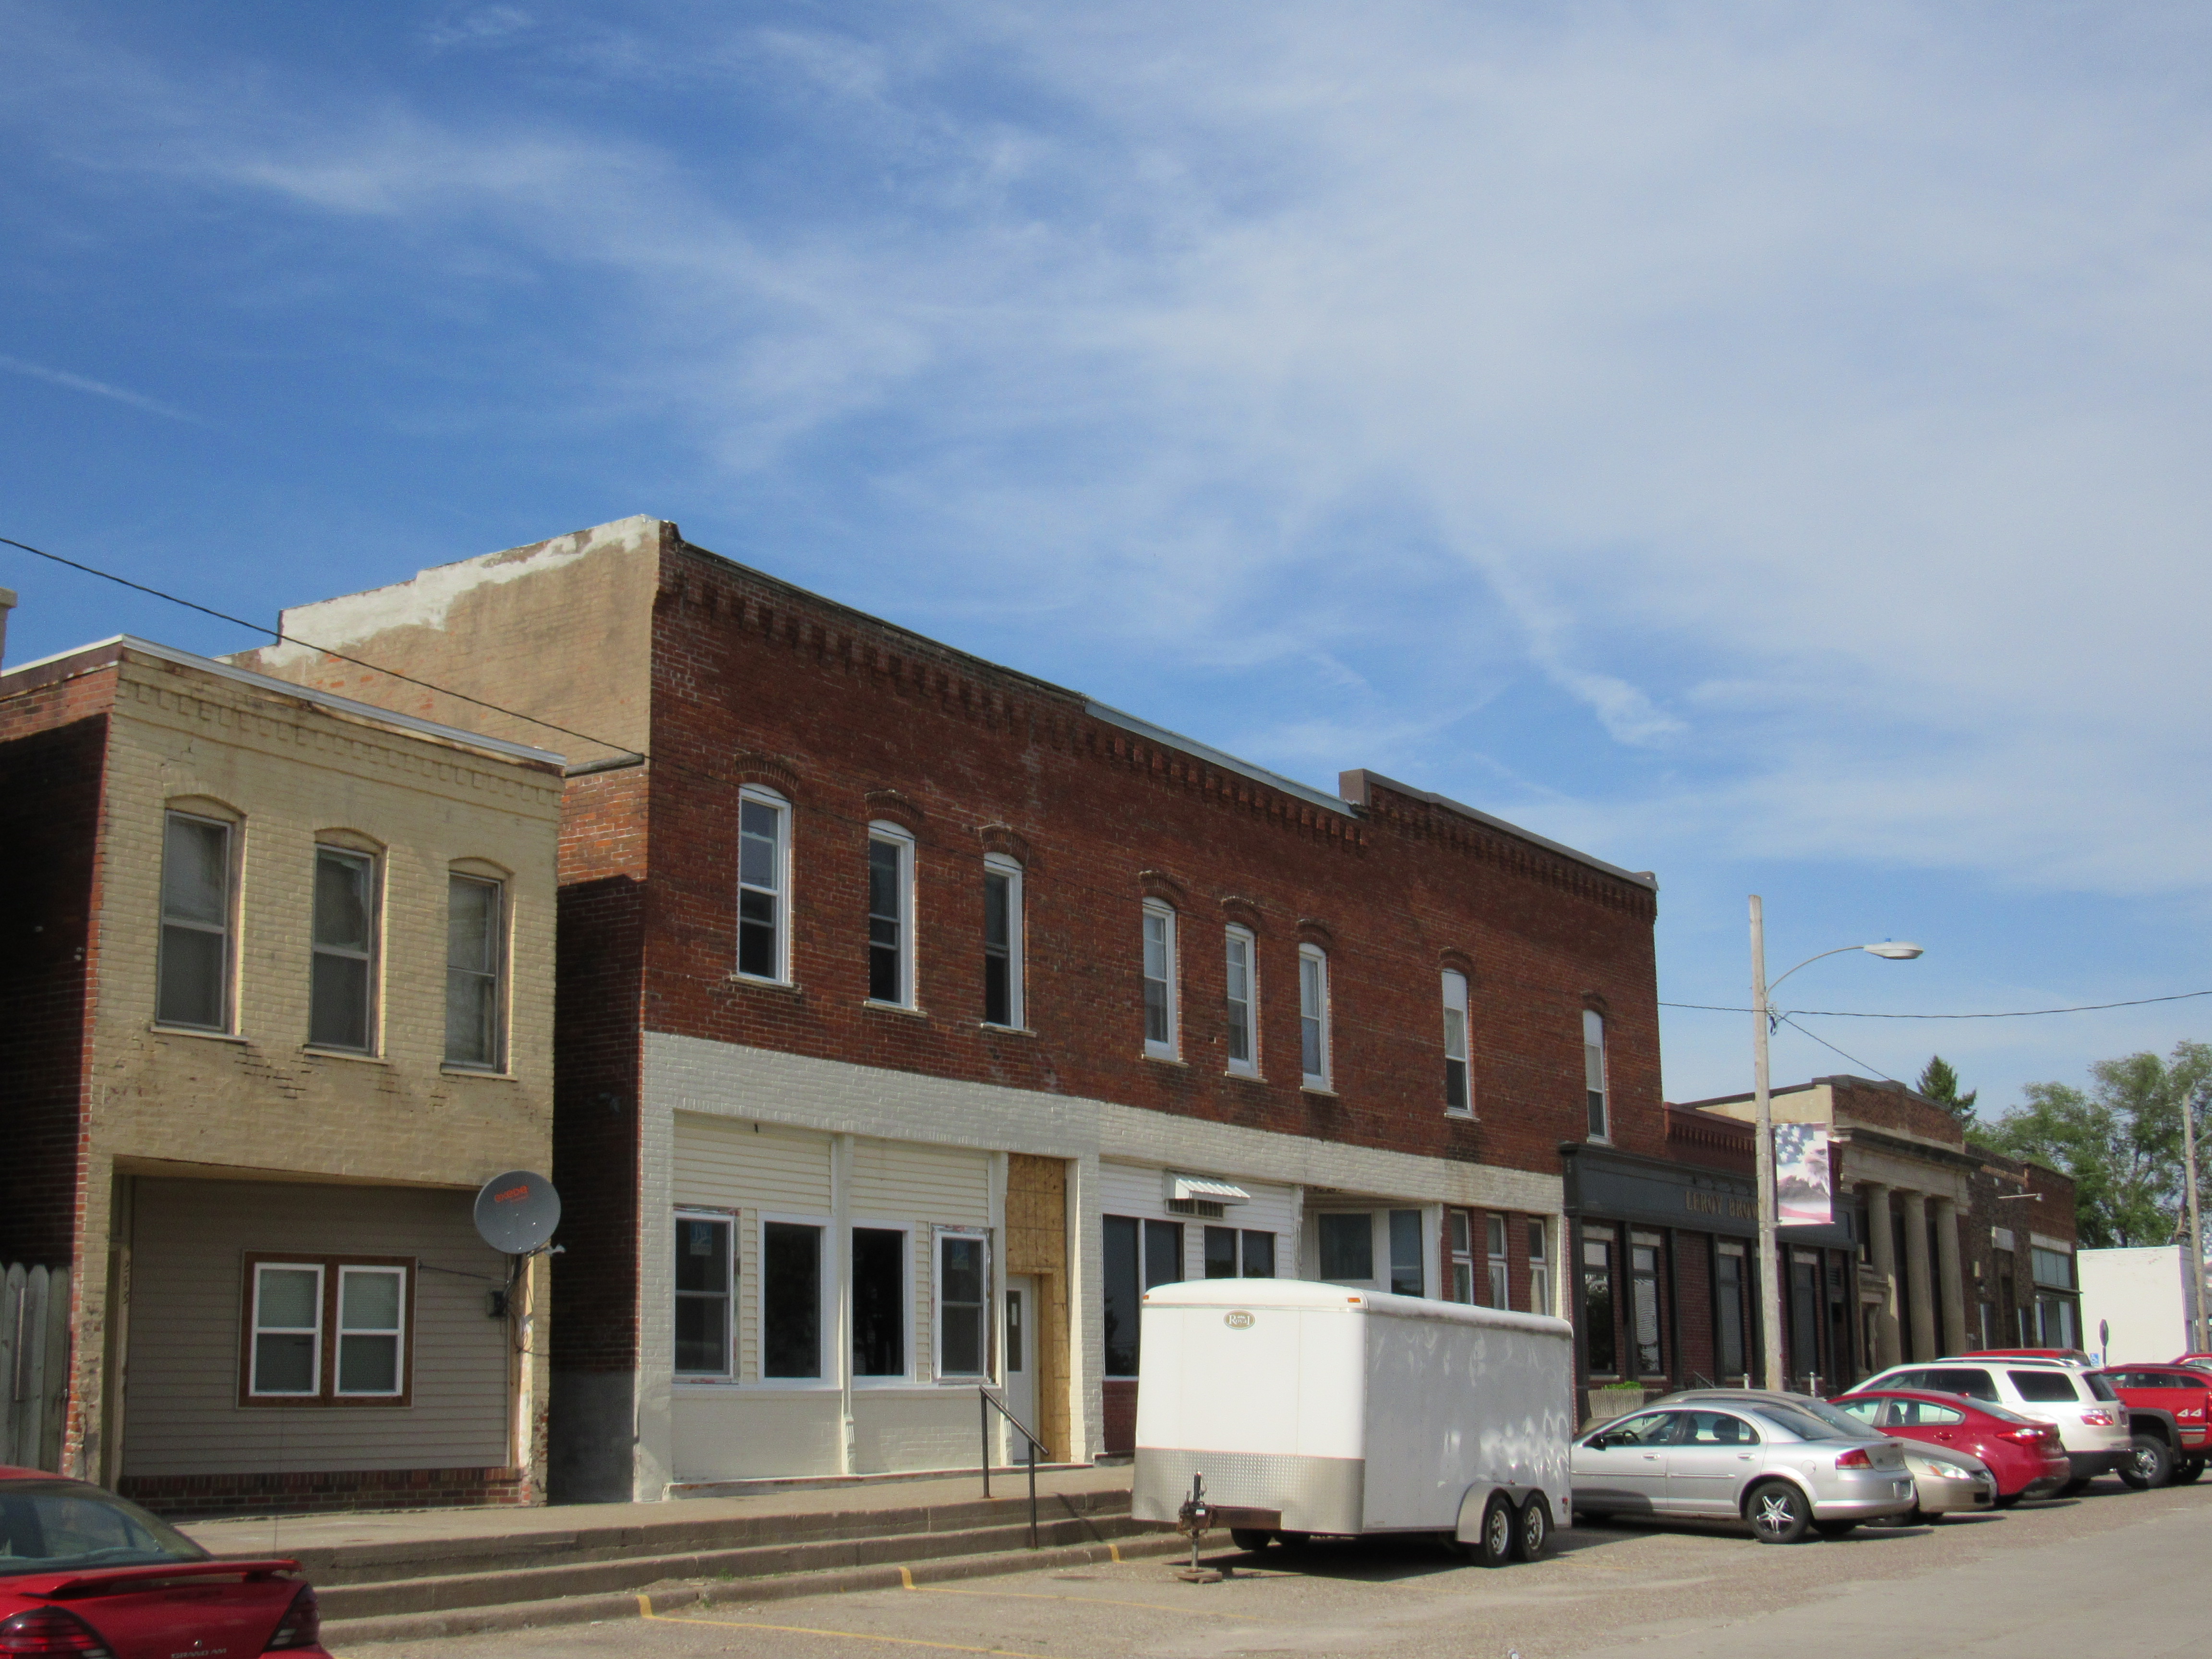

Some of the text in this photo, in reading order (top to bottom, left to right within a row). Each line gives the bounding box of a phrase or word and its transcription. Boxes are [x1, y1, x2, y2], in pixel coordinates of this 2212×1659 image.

[1686, 1191, 1758, 1220] LEROY BROW
[1229, 1315, 1250, 1325] Royal
[171, 1650, 208, 1659] GRAND
